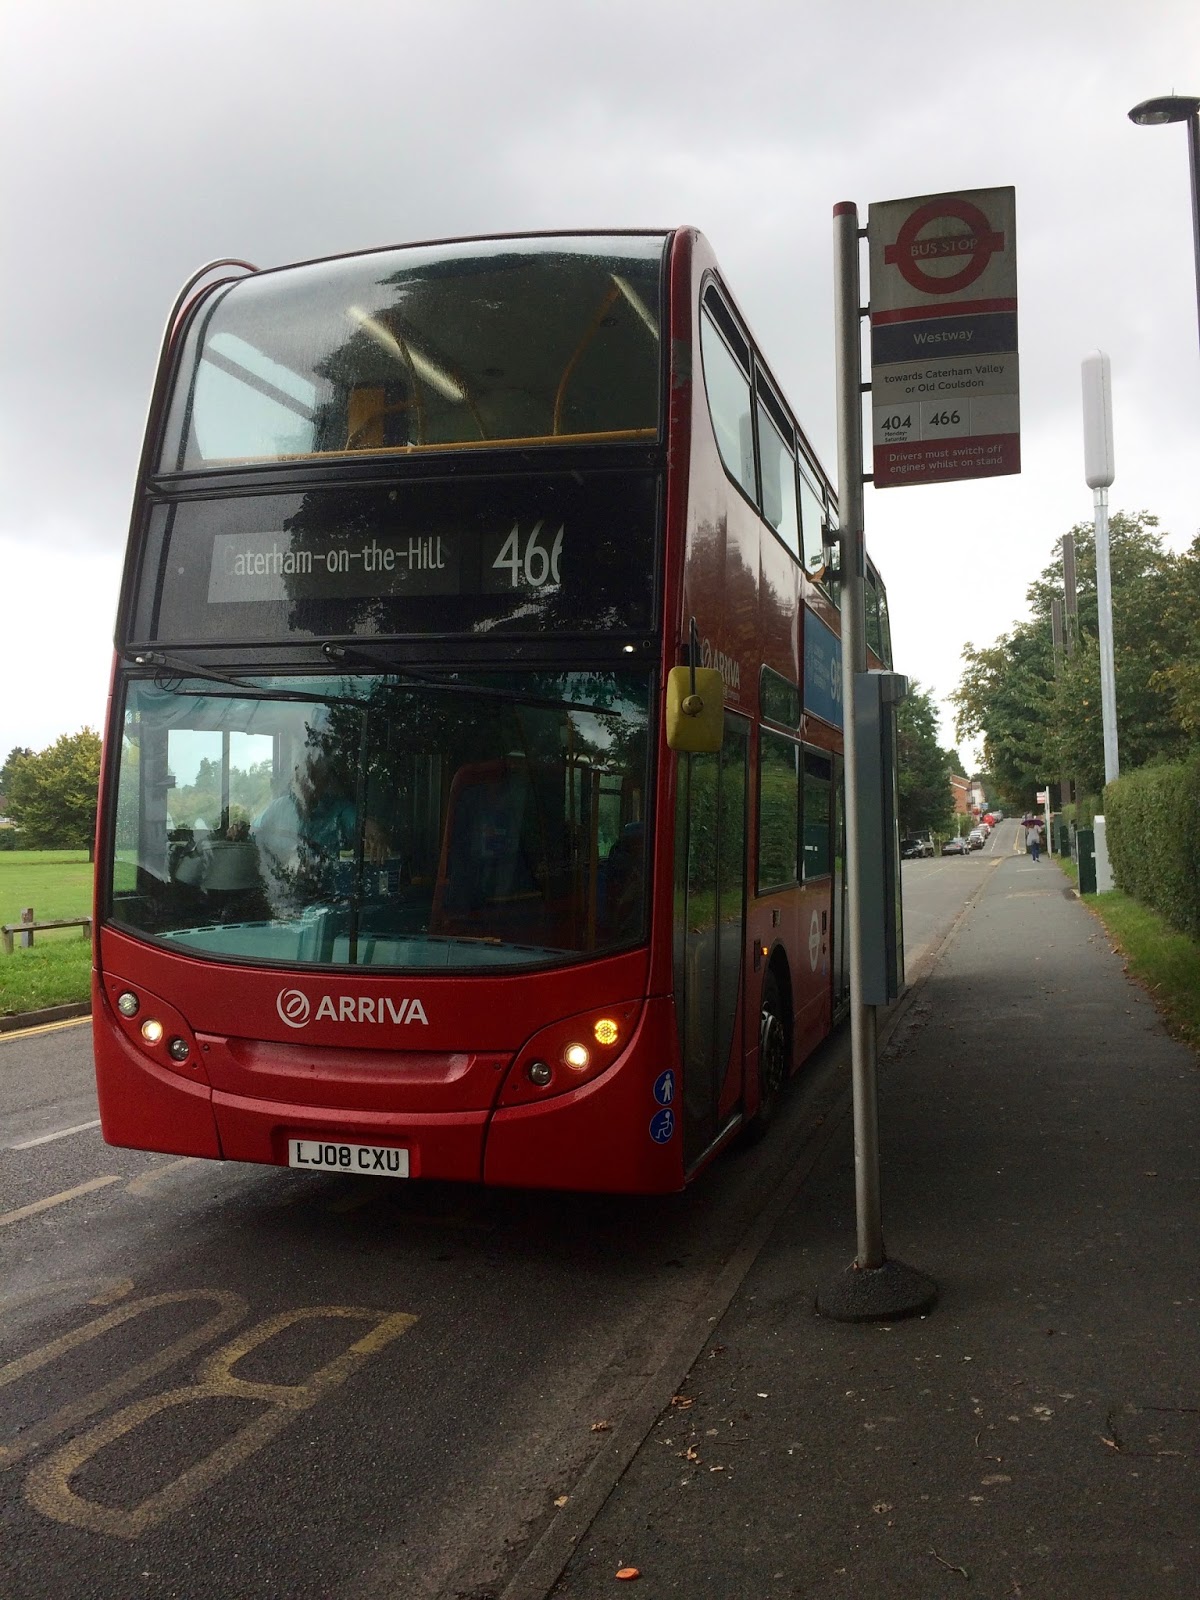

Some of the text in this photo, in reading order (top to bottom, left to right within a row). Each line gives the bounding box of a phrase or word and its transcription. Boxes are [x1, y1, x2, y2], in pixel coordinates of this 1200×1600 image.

[911, 239, 978, 257] BUS STOP
[913, 329, 973, 345] Westway
[884, 365, 1004, 383] towards Caterham Valley
[905, 379, 984, 394] or Old Coulsdon
[881, 414, 912, 430] 404
[929, 409, 961, 426] 466
[889, 445, 1002, 462] Drivers must switch off
[890, 462, 926, 474] engines
[929, 459, 958, 468] whilst
[976, 456, 1002, 466] stand
[315, 995, 429, 1025] ARRIVA
[297, 1142, 399, 1171] LJ08 CXU
